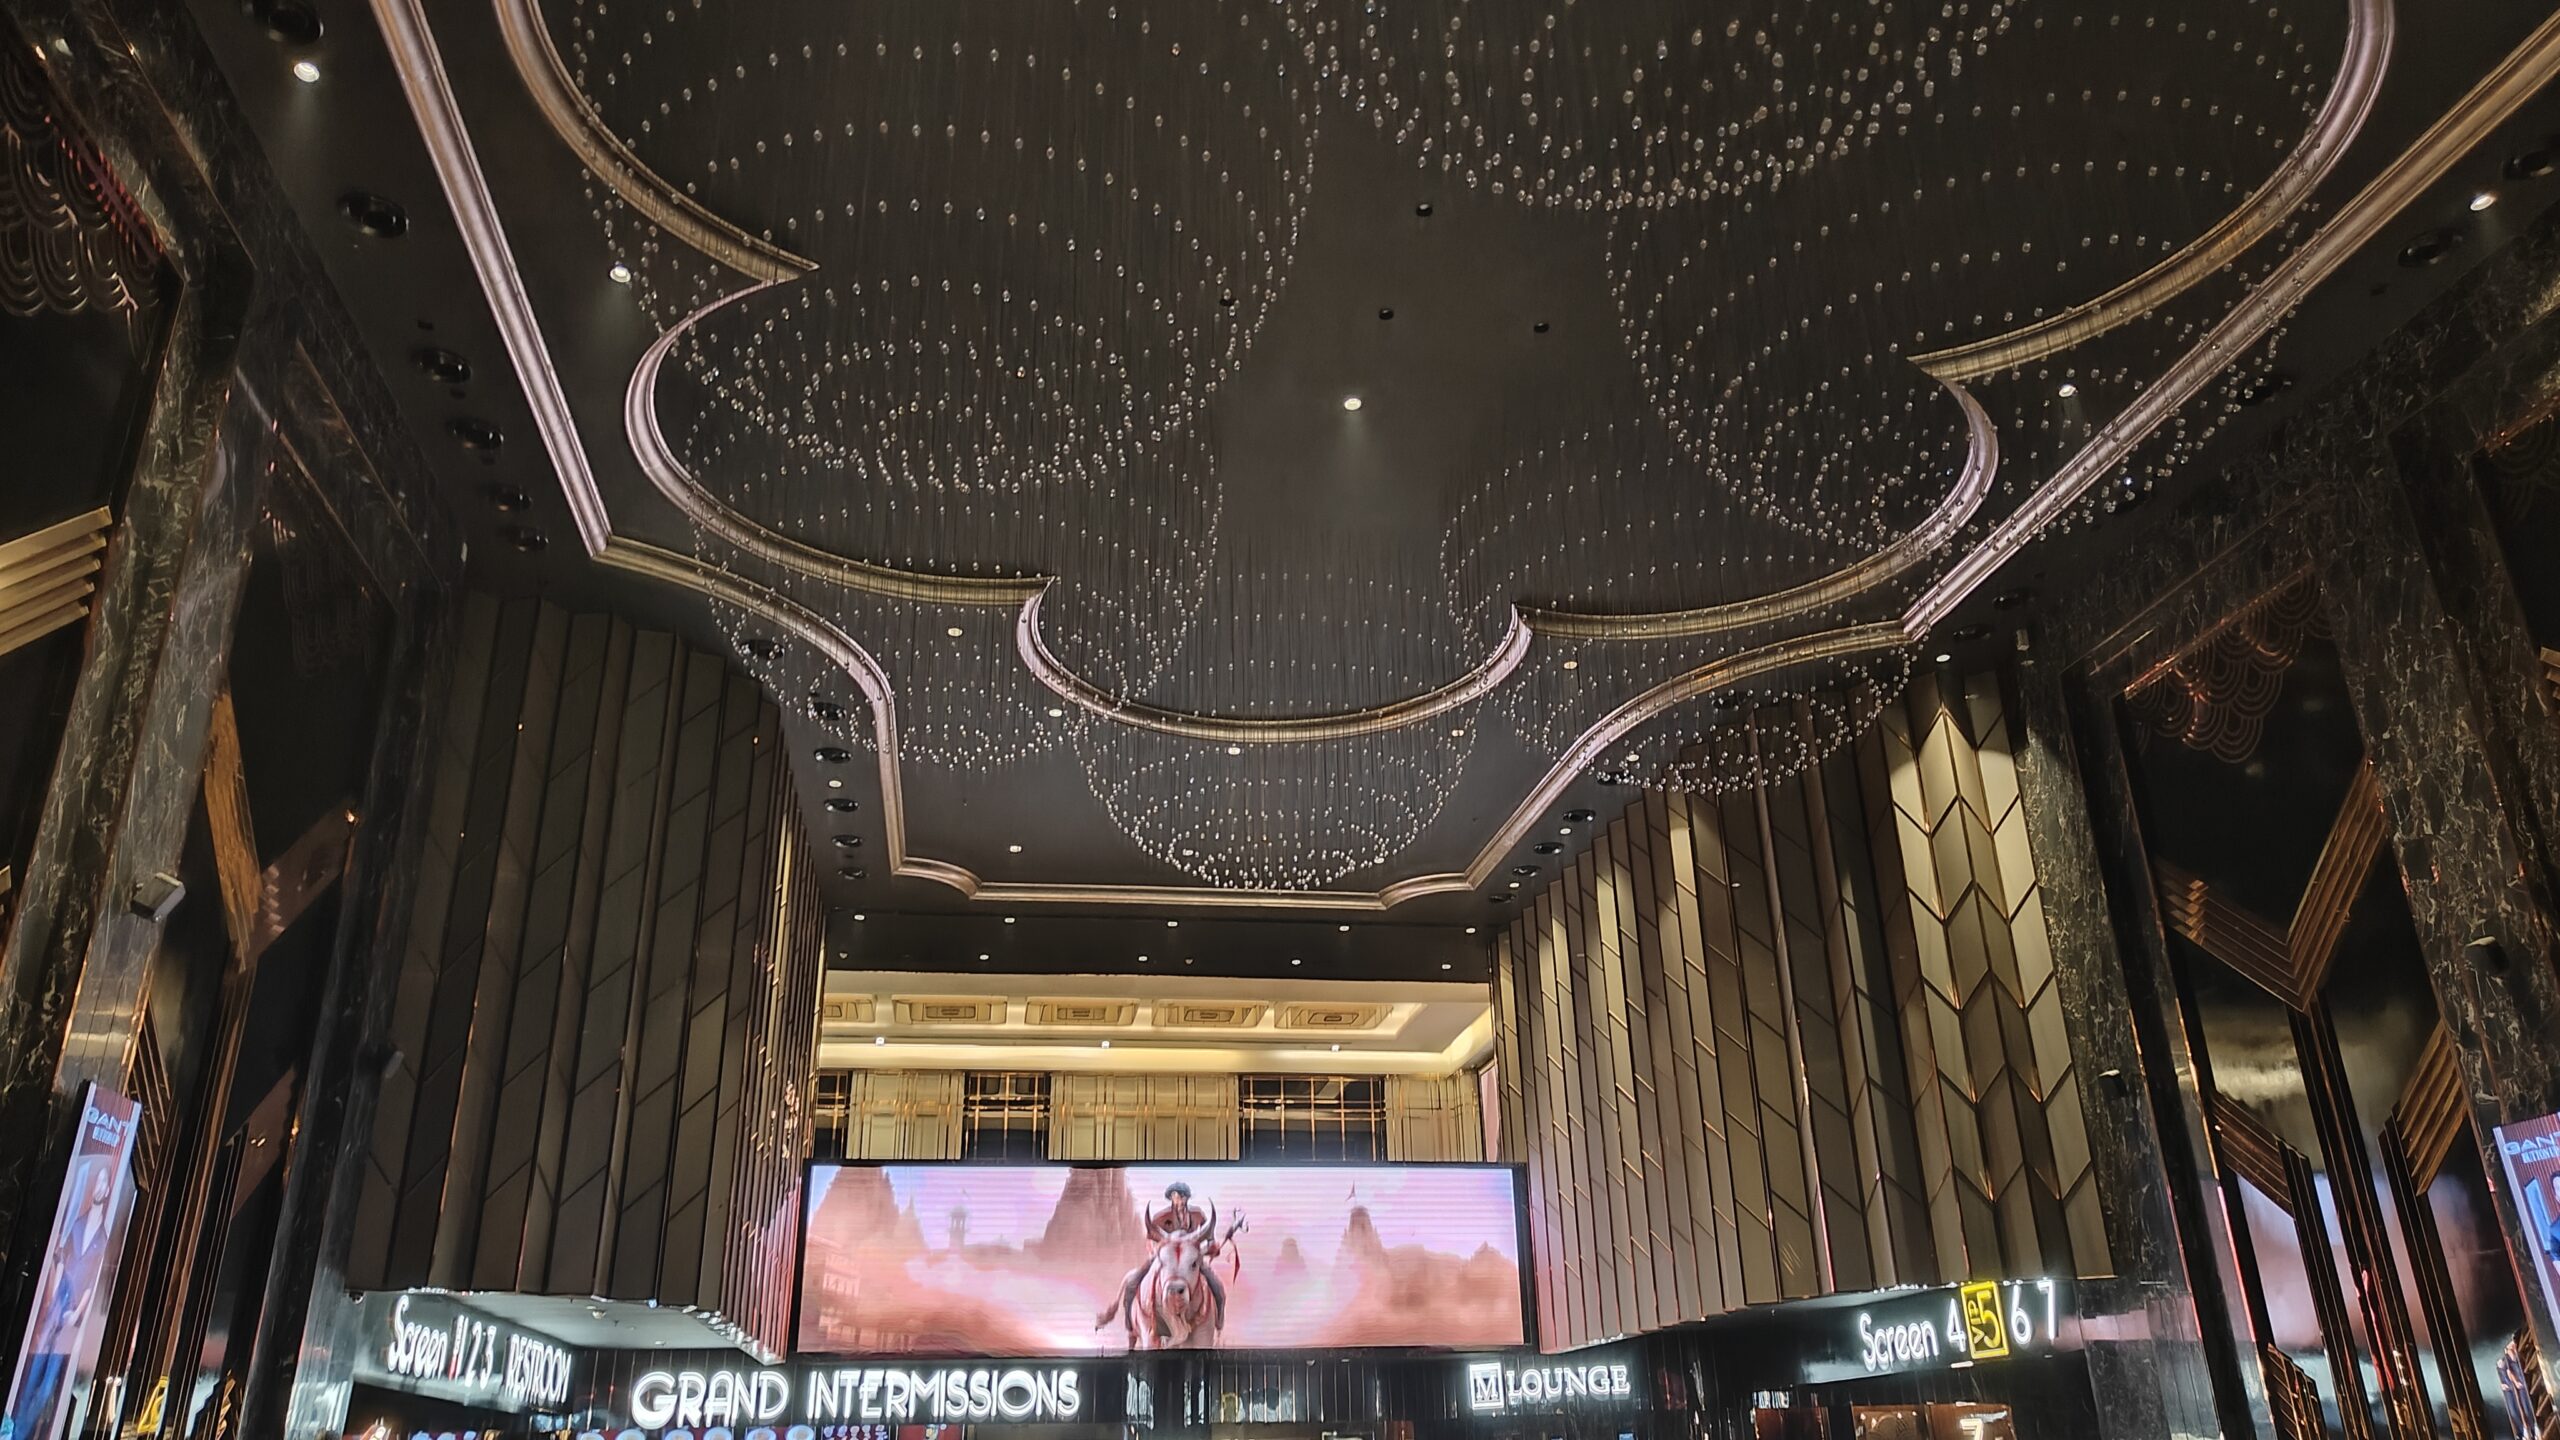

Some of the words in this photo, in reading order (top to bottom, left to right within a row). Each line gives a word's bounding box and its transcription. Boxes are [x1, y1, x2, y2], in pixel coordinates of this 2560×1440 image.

[388, 1295, 448, 1377] Screen
[465, 1321, 482, 1387] 2
[480, 1325, 497, 1390] 3
[505, 1333, 572, 1403] RESTROOM
[1860, 1312, 1939, 1371] Screen
[1947, 1298, 1966, 1352] 4
[1976, 1290, 2001, 1348] 5
[2011, 1284, 2033, 1345] 6
[2037, 1279, 2056, 1344] 7
[1968, 1300, 1985, 1344] VIP
[631, 1370, 790, 1429] GRAND
[807, 1369, 1081, 1421] INTERMISSIONS
[1506, 1364, 1631, 1400] LOUNGE
